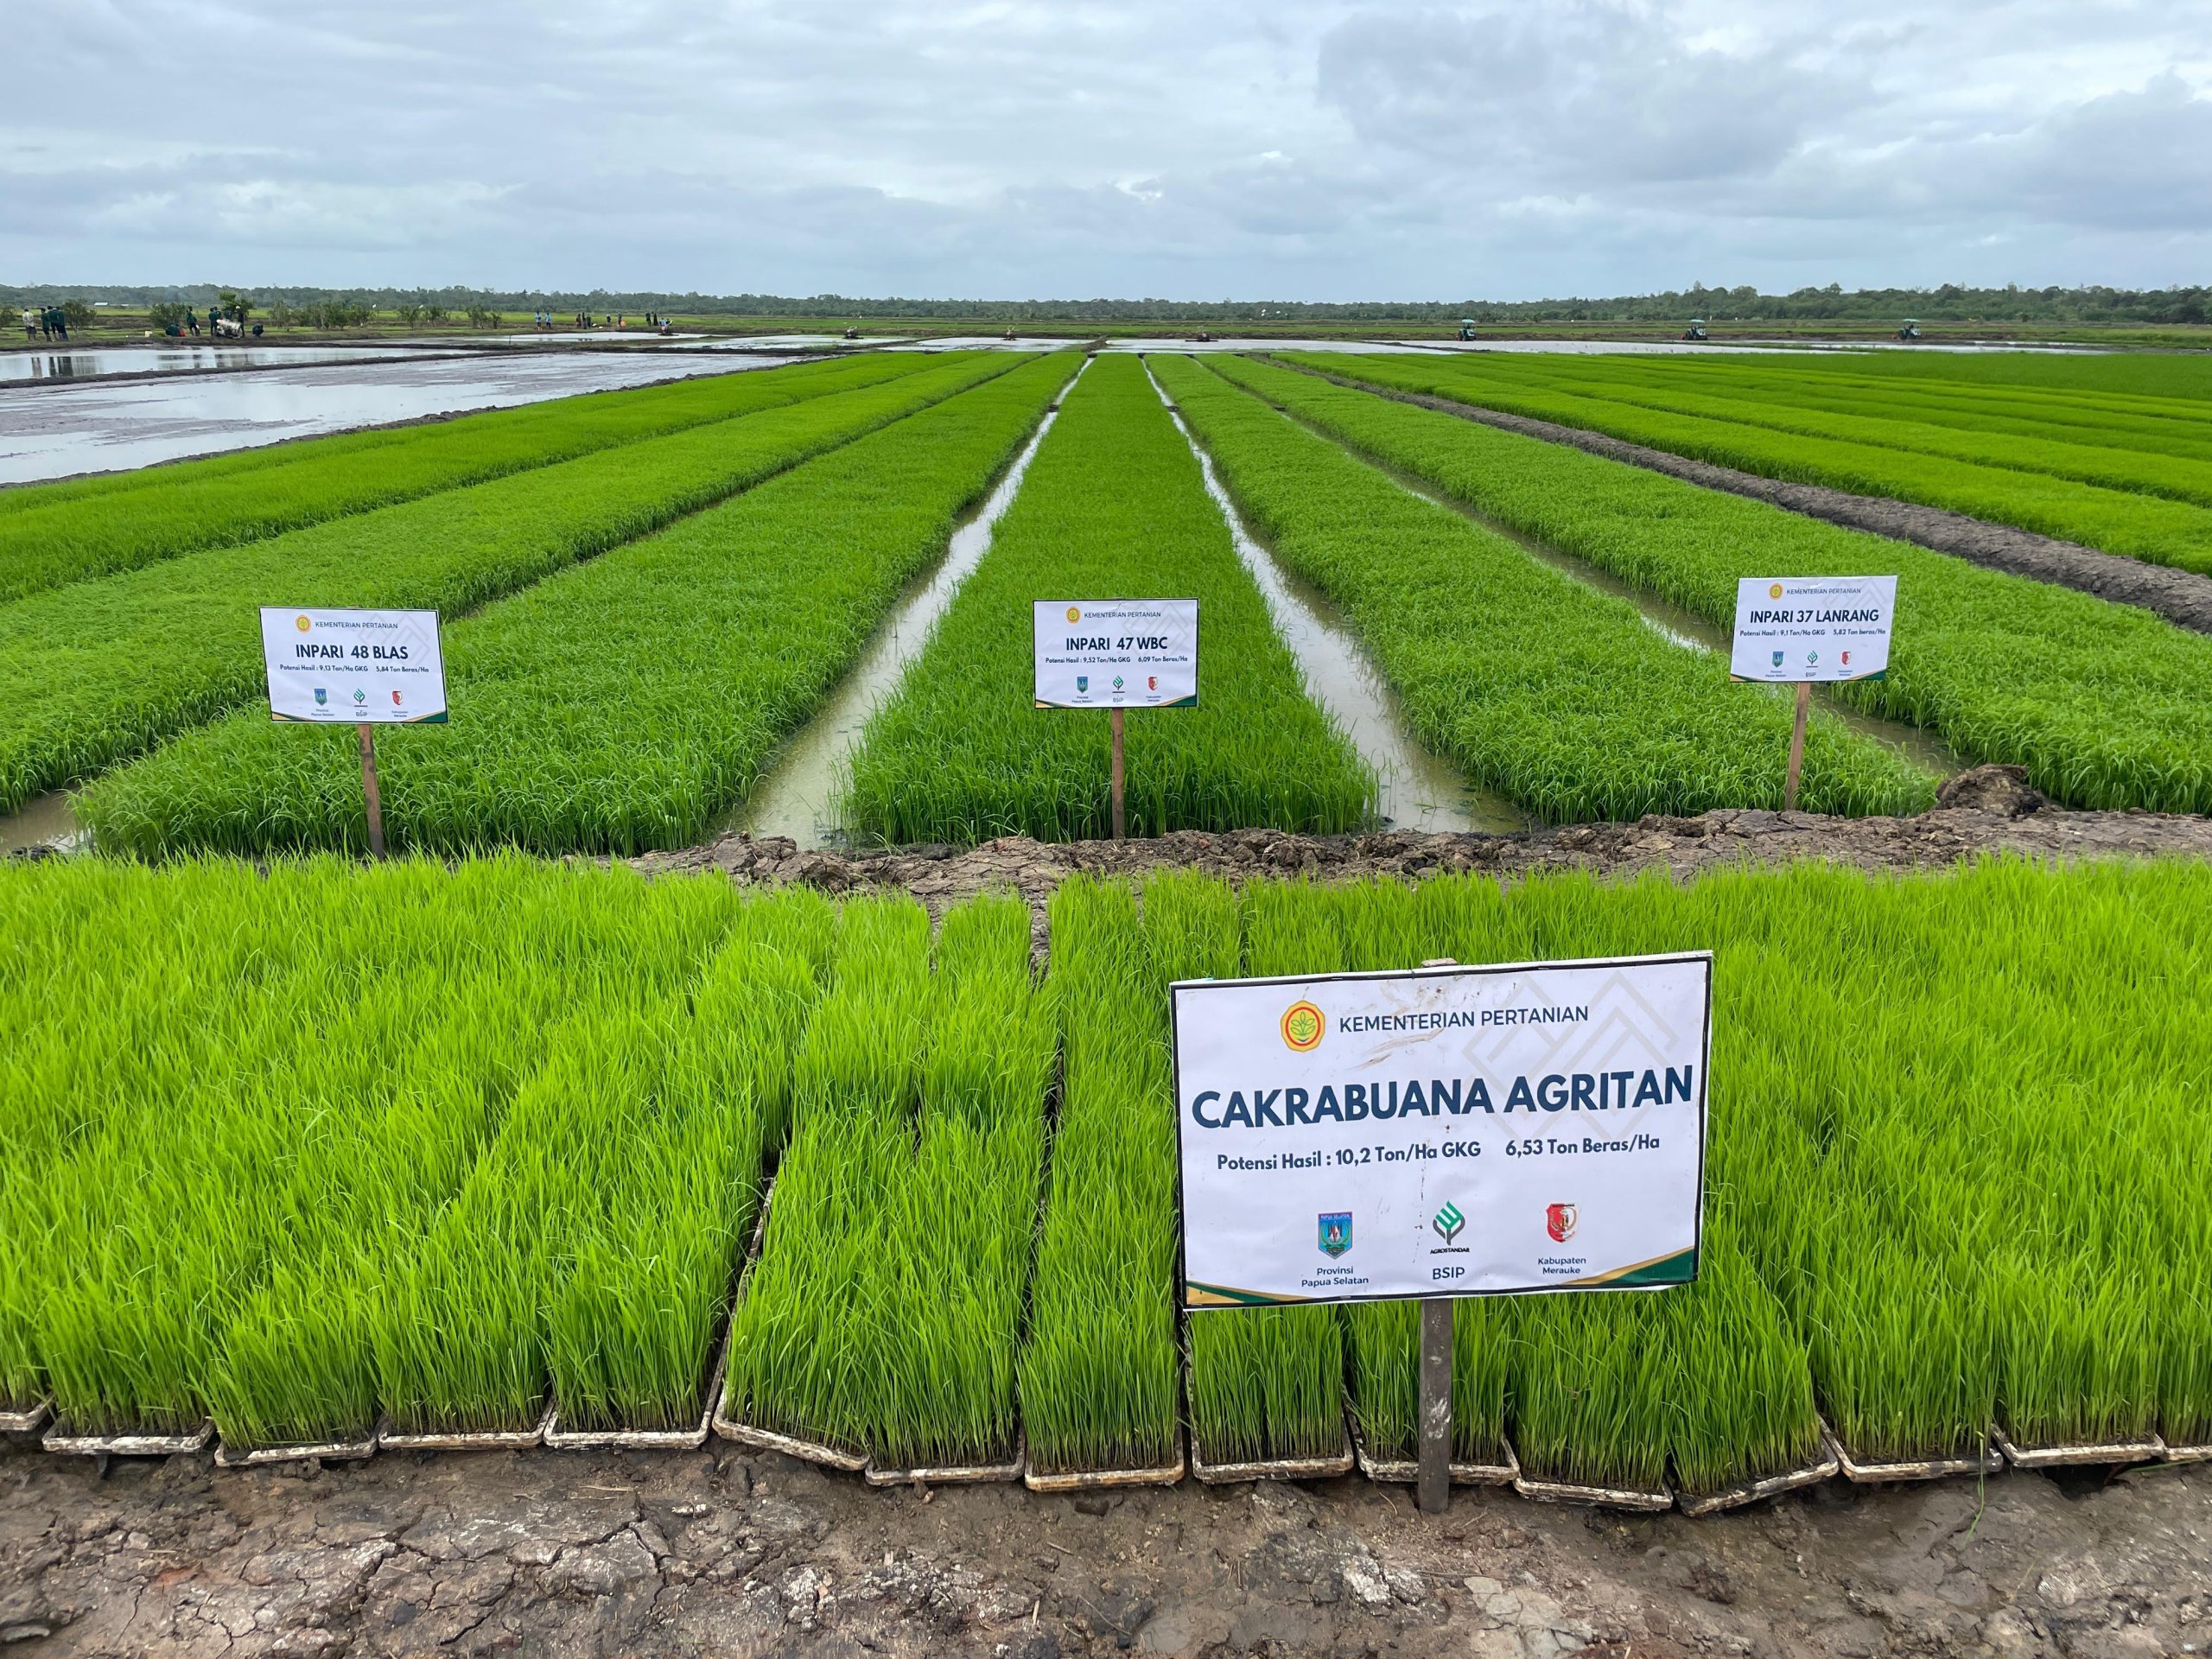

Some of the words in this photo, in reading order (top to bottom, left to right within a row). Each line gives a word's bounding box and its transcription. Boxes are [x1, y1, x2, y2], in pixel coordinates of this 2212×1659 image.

[1751, 611, 1793, 623] INPARI
[1796, 611, 1814, 622] 37
[1816, 610, 1878, 622] LANRANG
[1066, 638, 1109, 650] INPARI
[1116, 638, 1133, 650] 47
[1137, 637, 1167, 649] WBC
[296, 645, 343, 658] INPARI
[351, 645, 369, 658] 48
[373, 646, 409, 659] BLAS
[1339, 1010, 1477, 1033] KEMENTERIAN
[1481, 1005, 1588, 1027] PERTANIAN
[1192, 1077, 1496, 1129] CAKRABUANA
[1503, 1065, 1694, 1113] AGRITAN
[1217, 1154, 1279, 1171] Potensi
[1282, 1150, 1322, 1168] Hasil
[1336, 1148, 1372, 1168] 10,2
[1376, 1145, 1438, 1163] Ton/Ha
[1441, 1141, 1482, 1159] GKG
[1505, 1139, 1544, 1159] 6,53
[1548, 1138, 1579, 1155] Ton
[1582, 1134, 1660, 1154] Beras/Ha
[1317, 1266, 1353, 1275] Provinsi
[1433, 1267, 1465, 1280] BSIP
[1301, 1279, 1331, 1287] Papua
